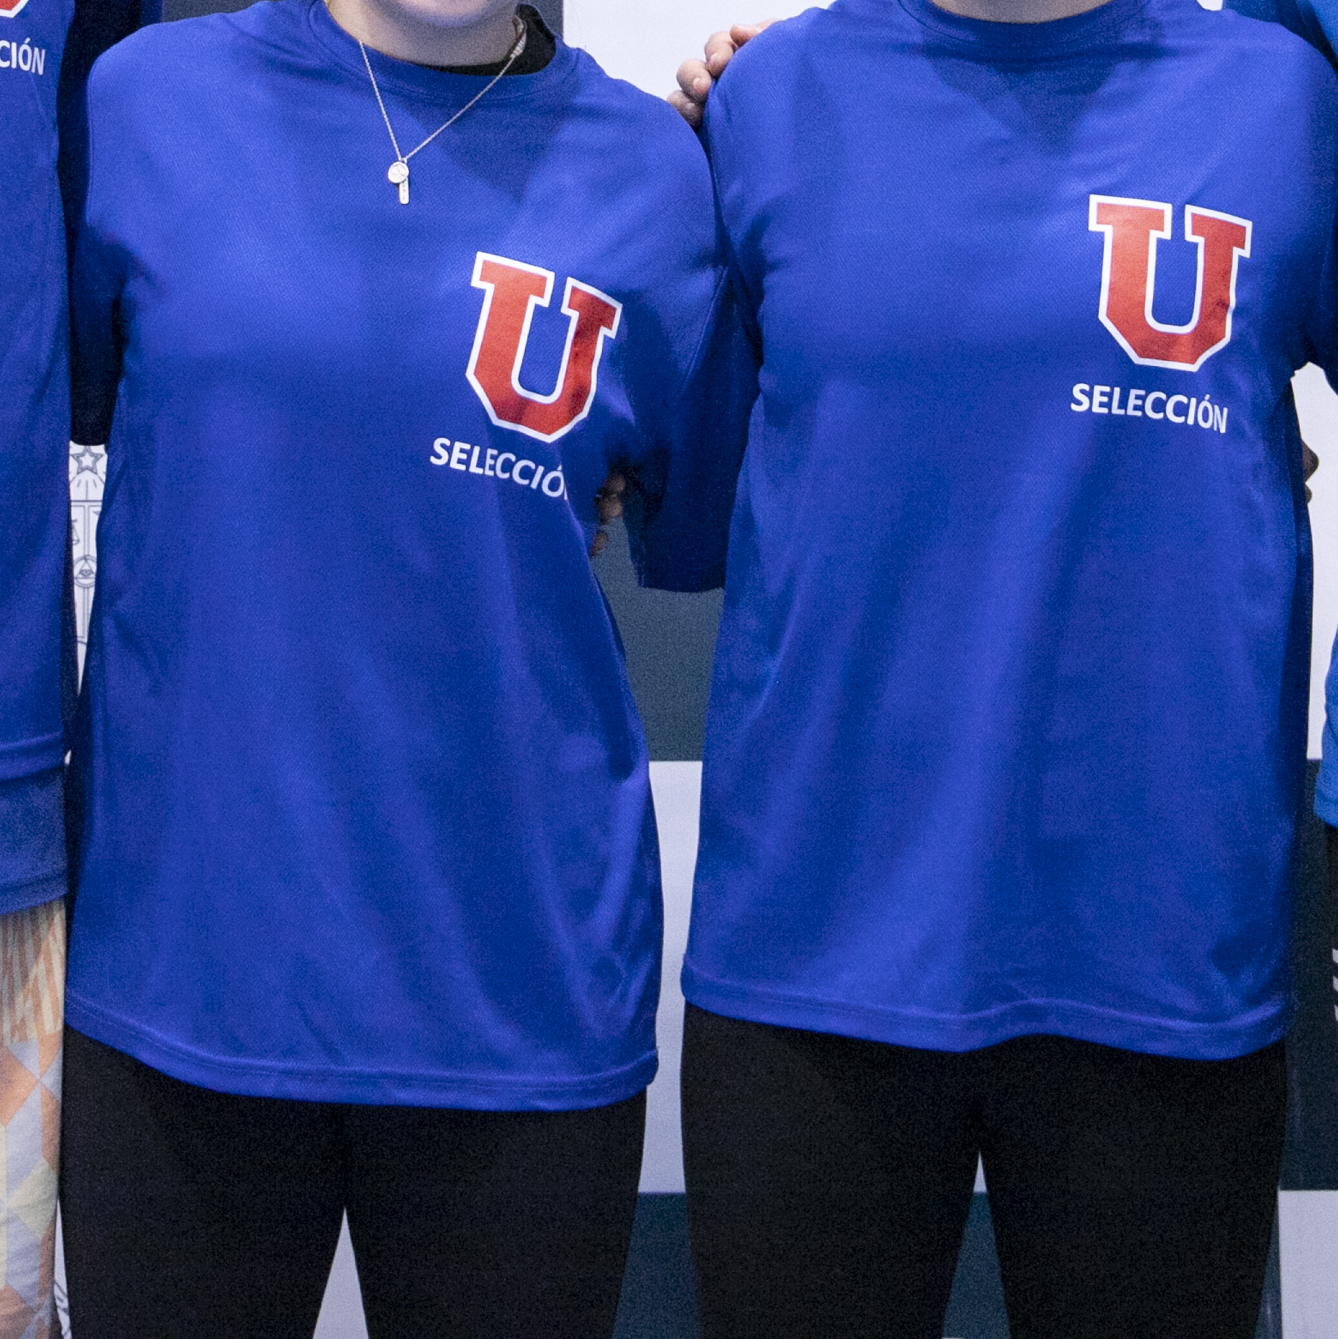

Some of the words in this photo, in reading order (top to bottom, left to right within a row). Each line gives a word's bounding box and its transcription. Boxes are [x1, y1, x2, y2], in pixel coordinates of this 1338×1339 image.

[1088, 194, 1253, 372] U
[465, 251, 623, 443] U
[1070, 382, 1228, 434] SELECCIÓN
[430, 437, 568, 501] SELECCIÓ
